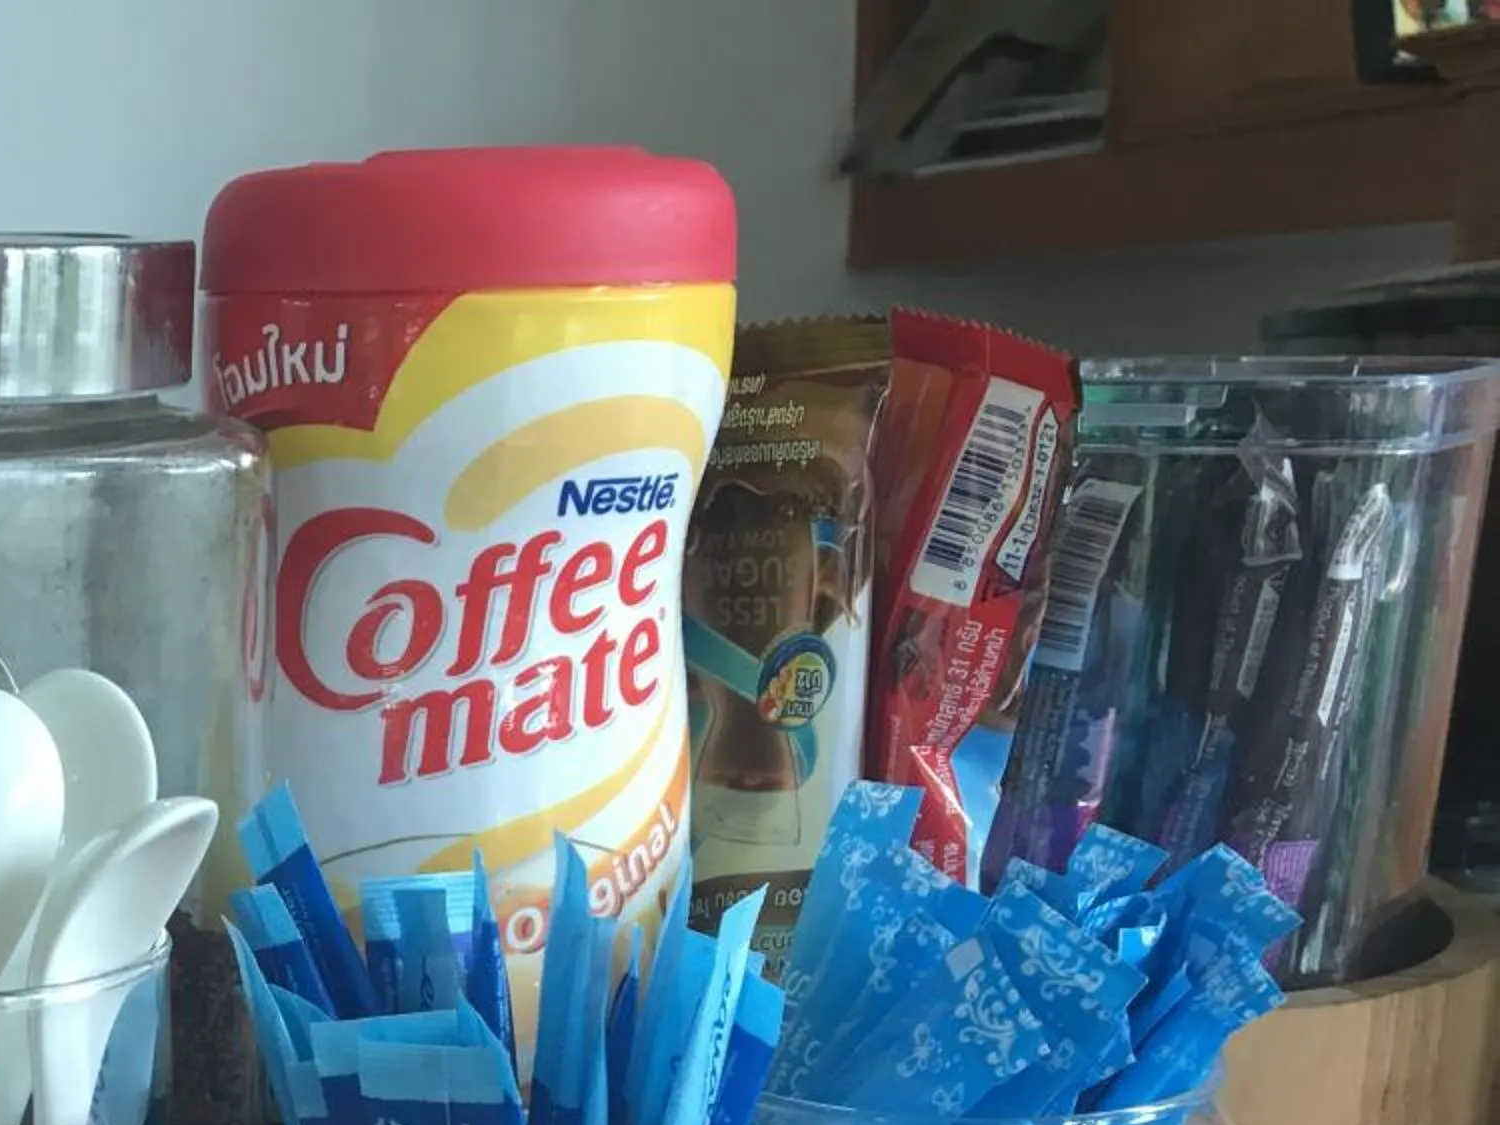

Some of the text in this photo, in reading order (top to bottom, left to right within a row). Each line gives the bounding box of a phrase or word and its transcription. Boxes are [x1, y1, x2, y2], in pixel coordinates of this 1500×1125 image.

[557, 472, 679, 519] Nestlé
[275, 506, 669, 709] Coffee
[717, 596, 782, 626] LESS
[956, 619, 983, 652] กรัม
[948, 658, 971, 679] 31
[377, 612, 661, 785] mate
[505, 801, 678, 953] oginal
